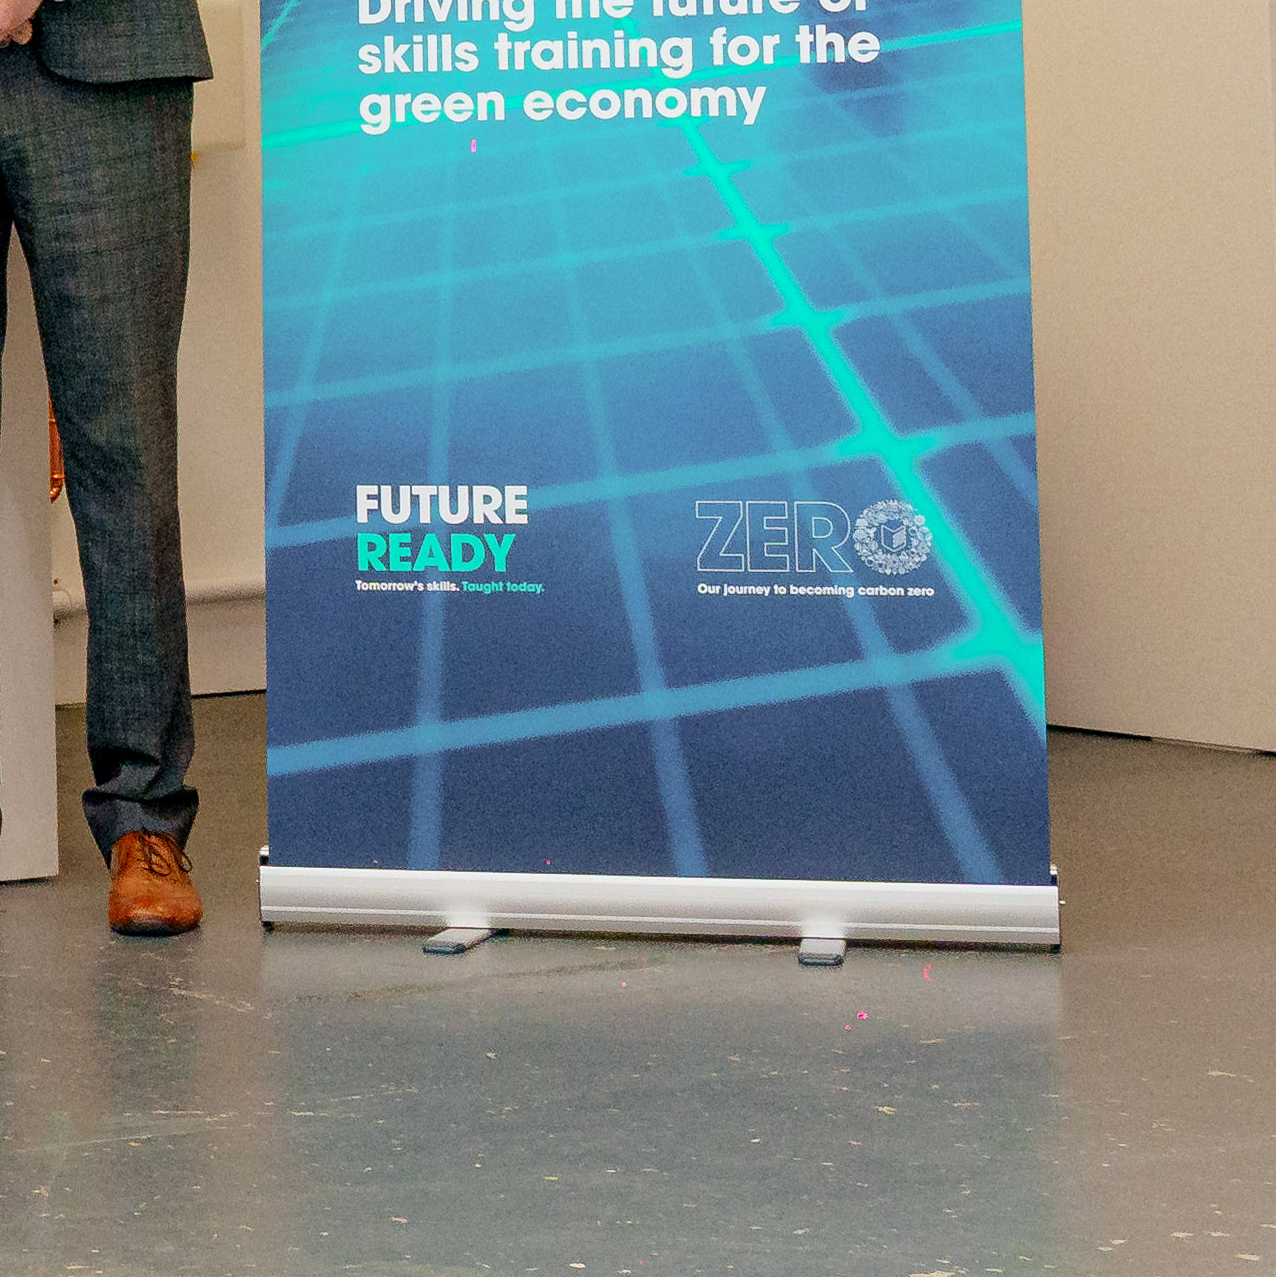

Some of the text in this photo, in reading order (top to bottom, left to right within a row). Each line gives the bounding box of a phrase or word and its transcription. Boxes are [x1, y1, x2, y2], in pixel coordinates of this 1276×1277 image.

[358, 24, 881, 78] skills training for the
[359, 85, 767, 135] green economy
[356, 485, 529, 524] FUTURE
[357, 532, 516, 572] READY
[355, 579, 545, 594] Tomorrow's skills. Taught today.
[697, 583, 935, 598] Our journey to becoming carbon zero
